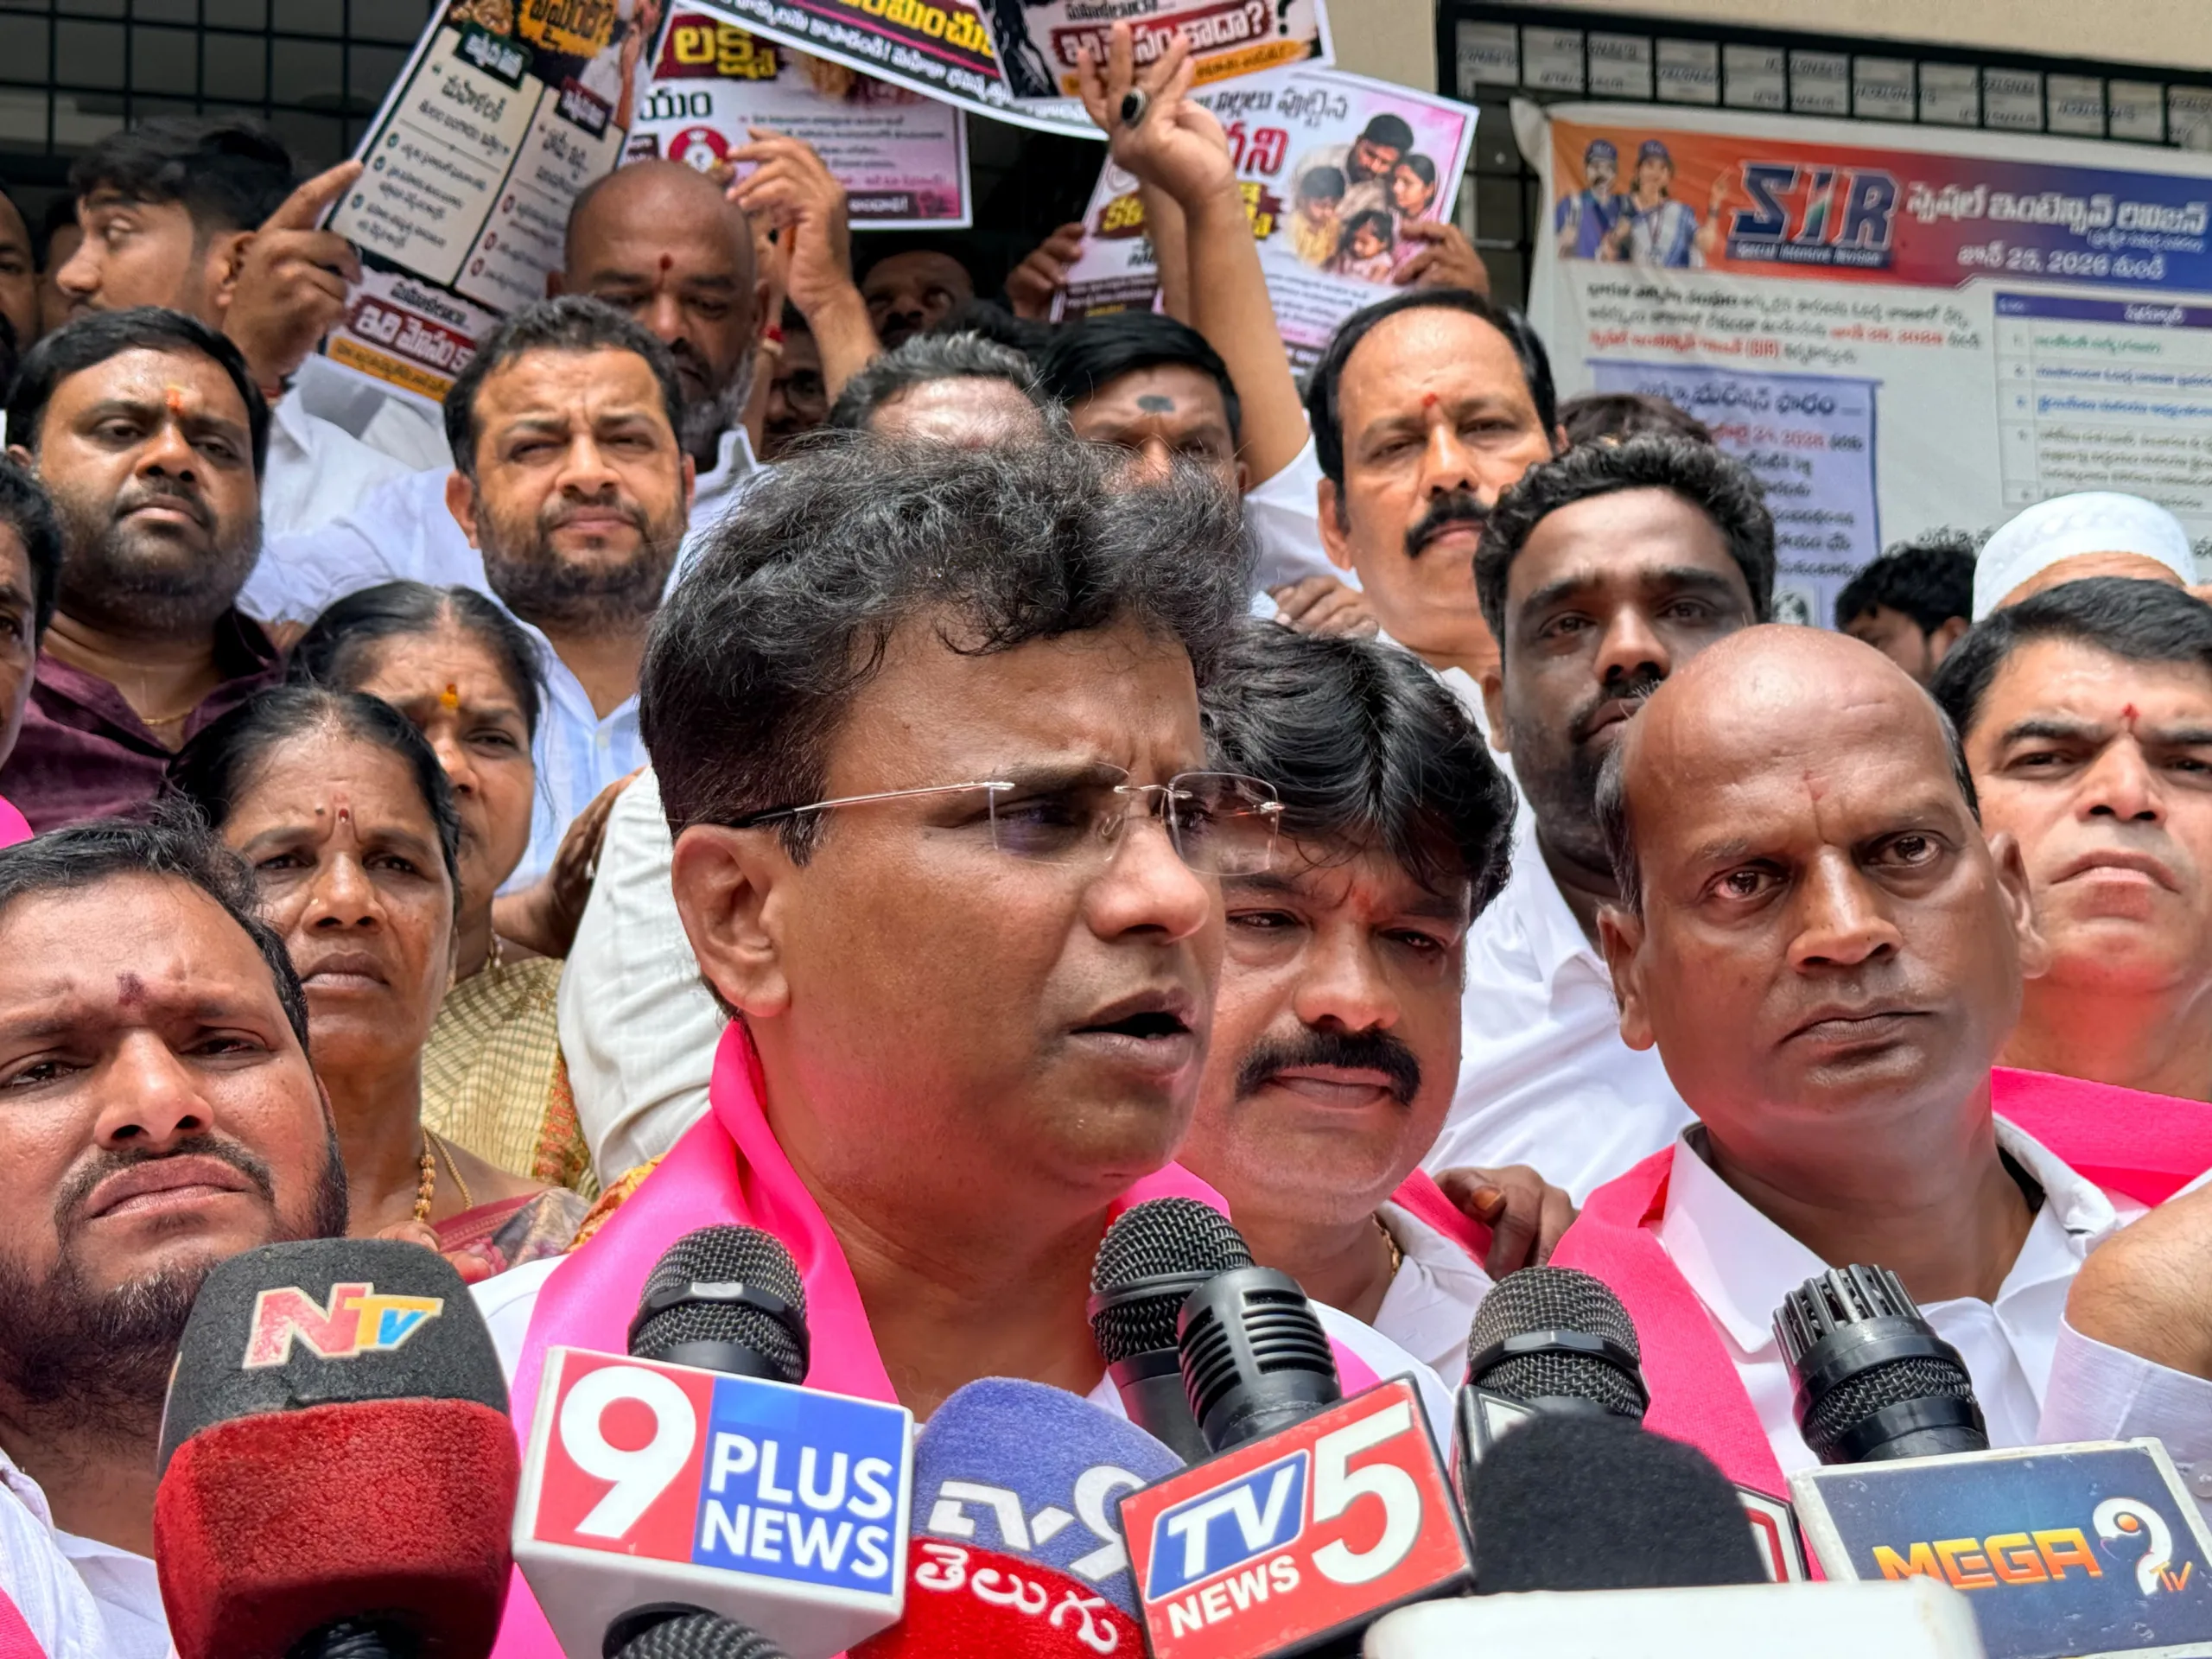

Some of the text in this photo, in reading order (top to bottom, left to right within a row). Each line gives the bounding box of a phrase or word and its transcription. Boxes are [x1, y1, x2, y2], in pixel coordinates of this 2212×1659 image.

[1728, 160, 1901, 251] SIR
[1906, 180, 1987, 224] స్పెషల్
[2047, 250, 2110, 276] 2026
[243, 1282, 443, 1370] NTV
[559, 1365, 696, 1540] 9
[708, 1432, 893, 1519] PLUS
[701, 1499, 889, 1579] NEWS
[1872, 1527, 2102, 1589] MEGA
[914, 1542, 1119, 1654] తెలుగు
[1166, 1554, 1300, 1639] NEWS
